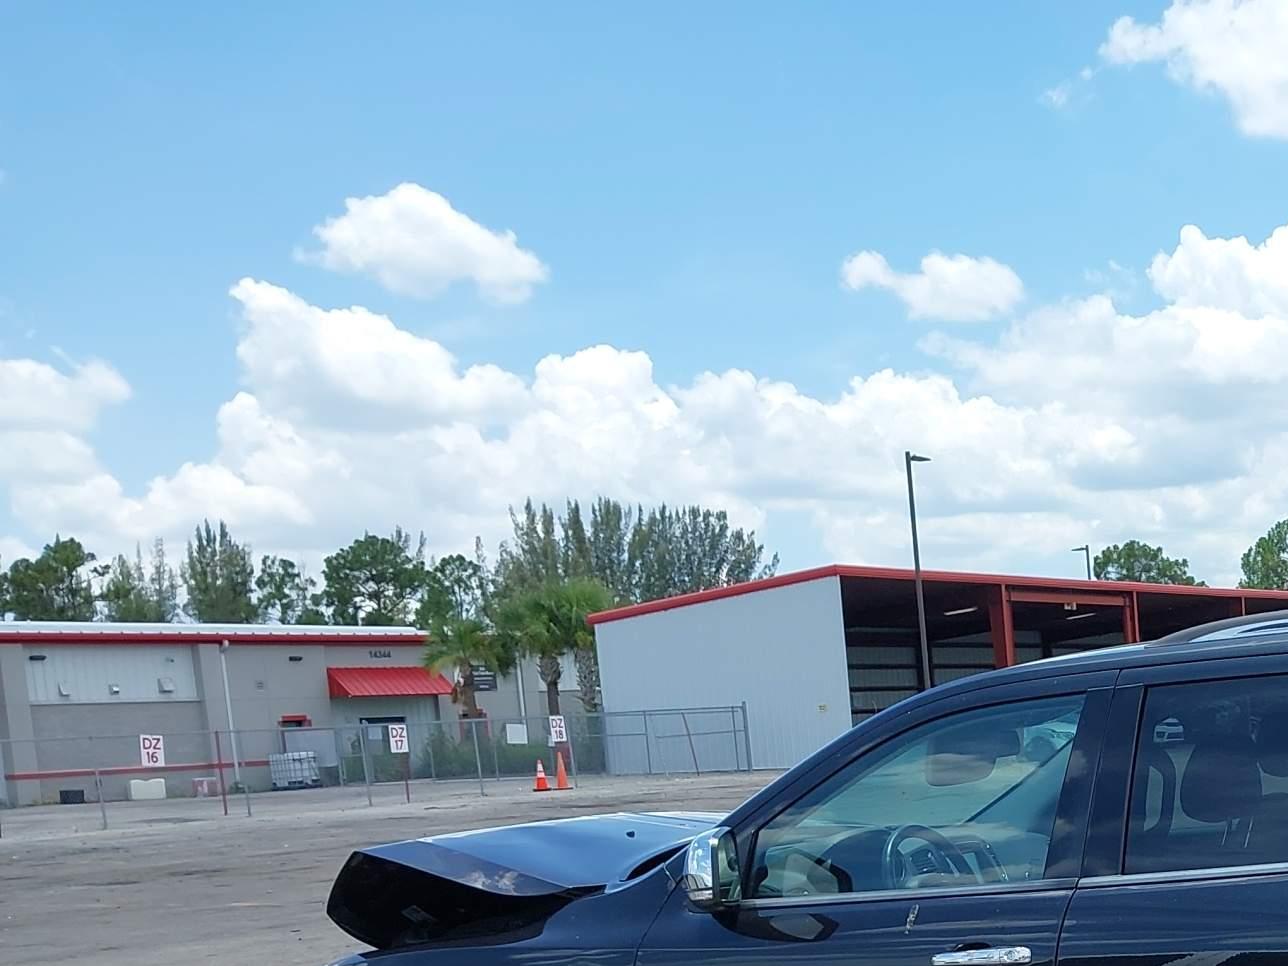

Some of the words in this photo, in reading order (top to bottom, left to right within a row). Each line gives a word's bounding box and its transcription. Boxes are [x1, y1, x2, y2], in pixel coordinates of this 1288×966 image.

[551, 718, 564, 729] DZ
[390, 727, 405, 738] DZ
[554, 729, 564, 739] 18
[142, 737, 162, 750] DZ
[395, 740, 404, 750] 17
[146, 752, 158, 764] 16
